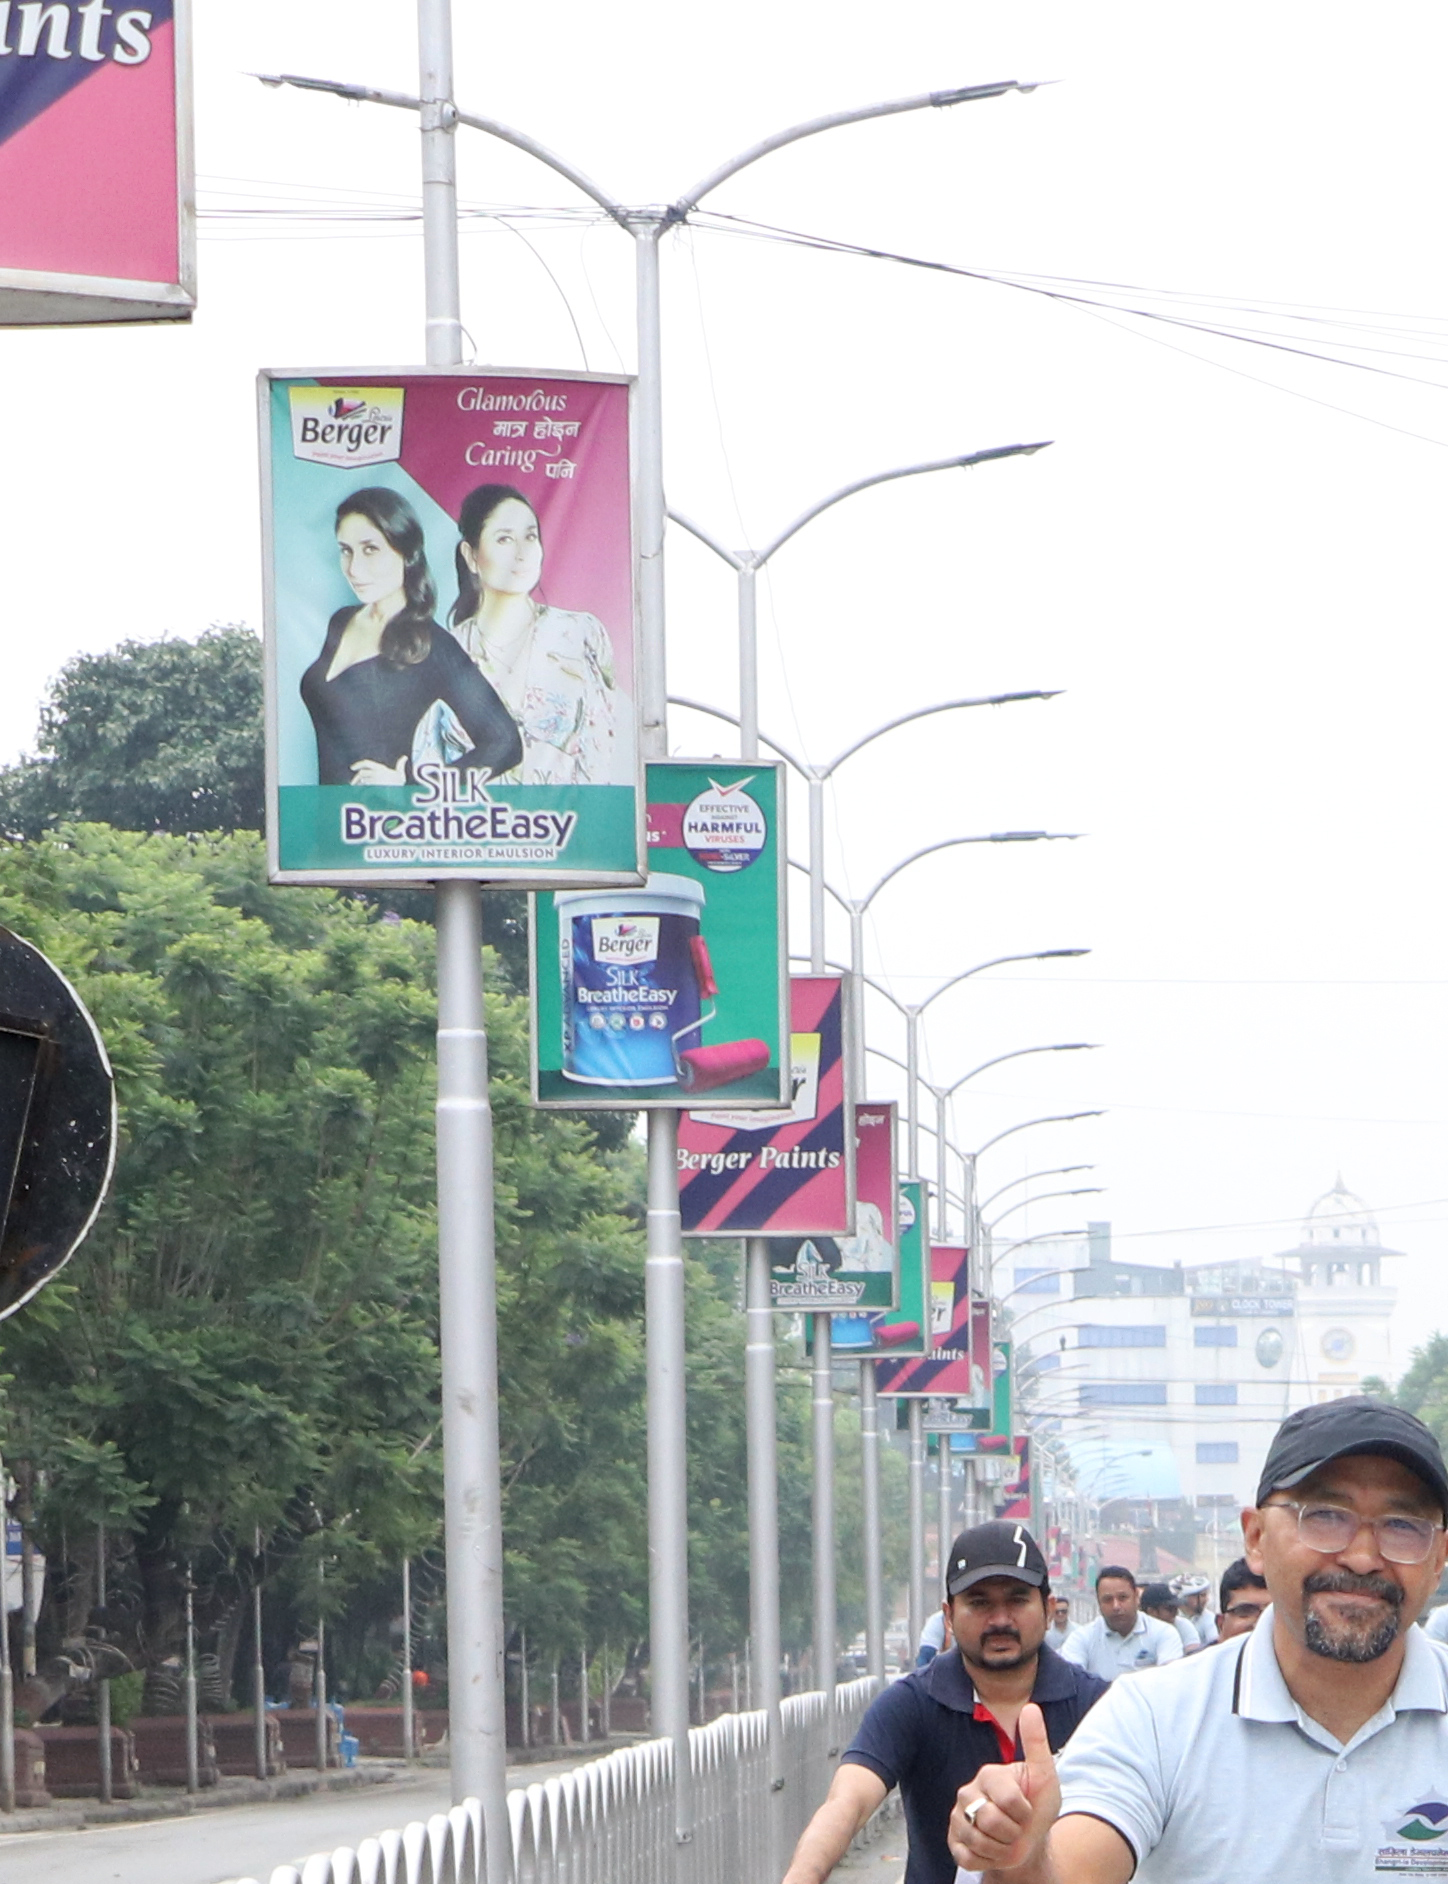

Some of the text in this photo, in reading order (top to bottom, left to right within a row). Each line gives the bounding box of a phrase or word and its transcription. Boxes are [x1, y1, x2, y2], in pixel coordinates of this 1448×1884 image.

[457, 386, 568, 412] Glamorous
[301, 416, 393, 453] Berger
[492, 415, 582, 441] मात्र होइन
[465, 441, 563, 473] Caring
[545, 458, 578, 479] पनि
[415, 763, 491, 804] SILK
[699, 804, 749, 813] EFFECTIVE
[344, 806, 575, 847] BreatheEasy
[688, 821, 762, 834] HARMFUL
[704, 835, 746, 844] VIRUSES
[366, 847, 555, 860] LUXURY INTERIOR EMULSION
[598, 936, 653, 957] Berger
[605, 966, 640, 987] SILK
[577, 986, 678, 1006] BreatheEasy
[677, 1146, 841, 1176] Berger Paints
[770, 1281, 865, 1297] BreatheEasy
